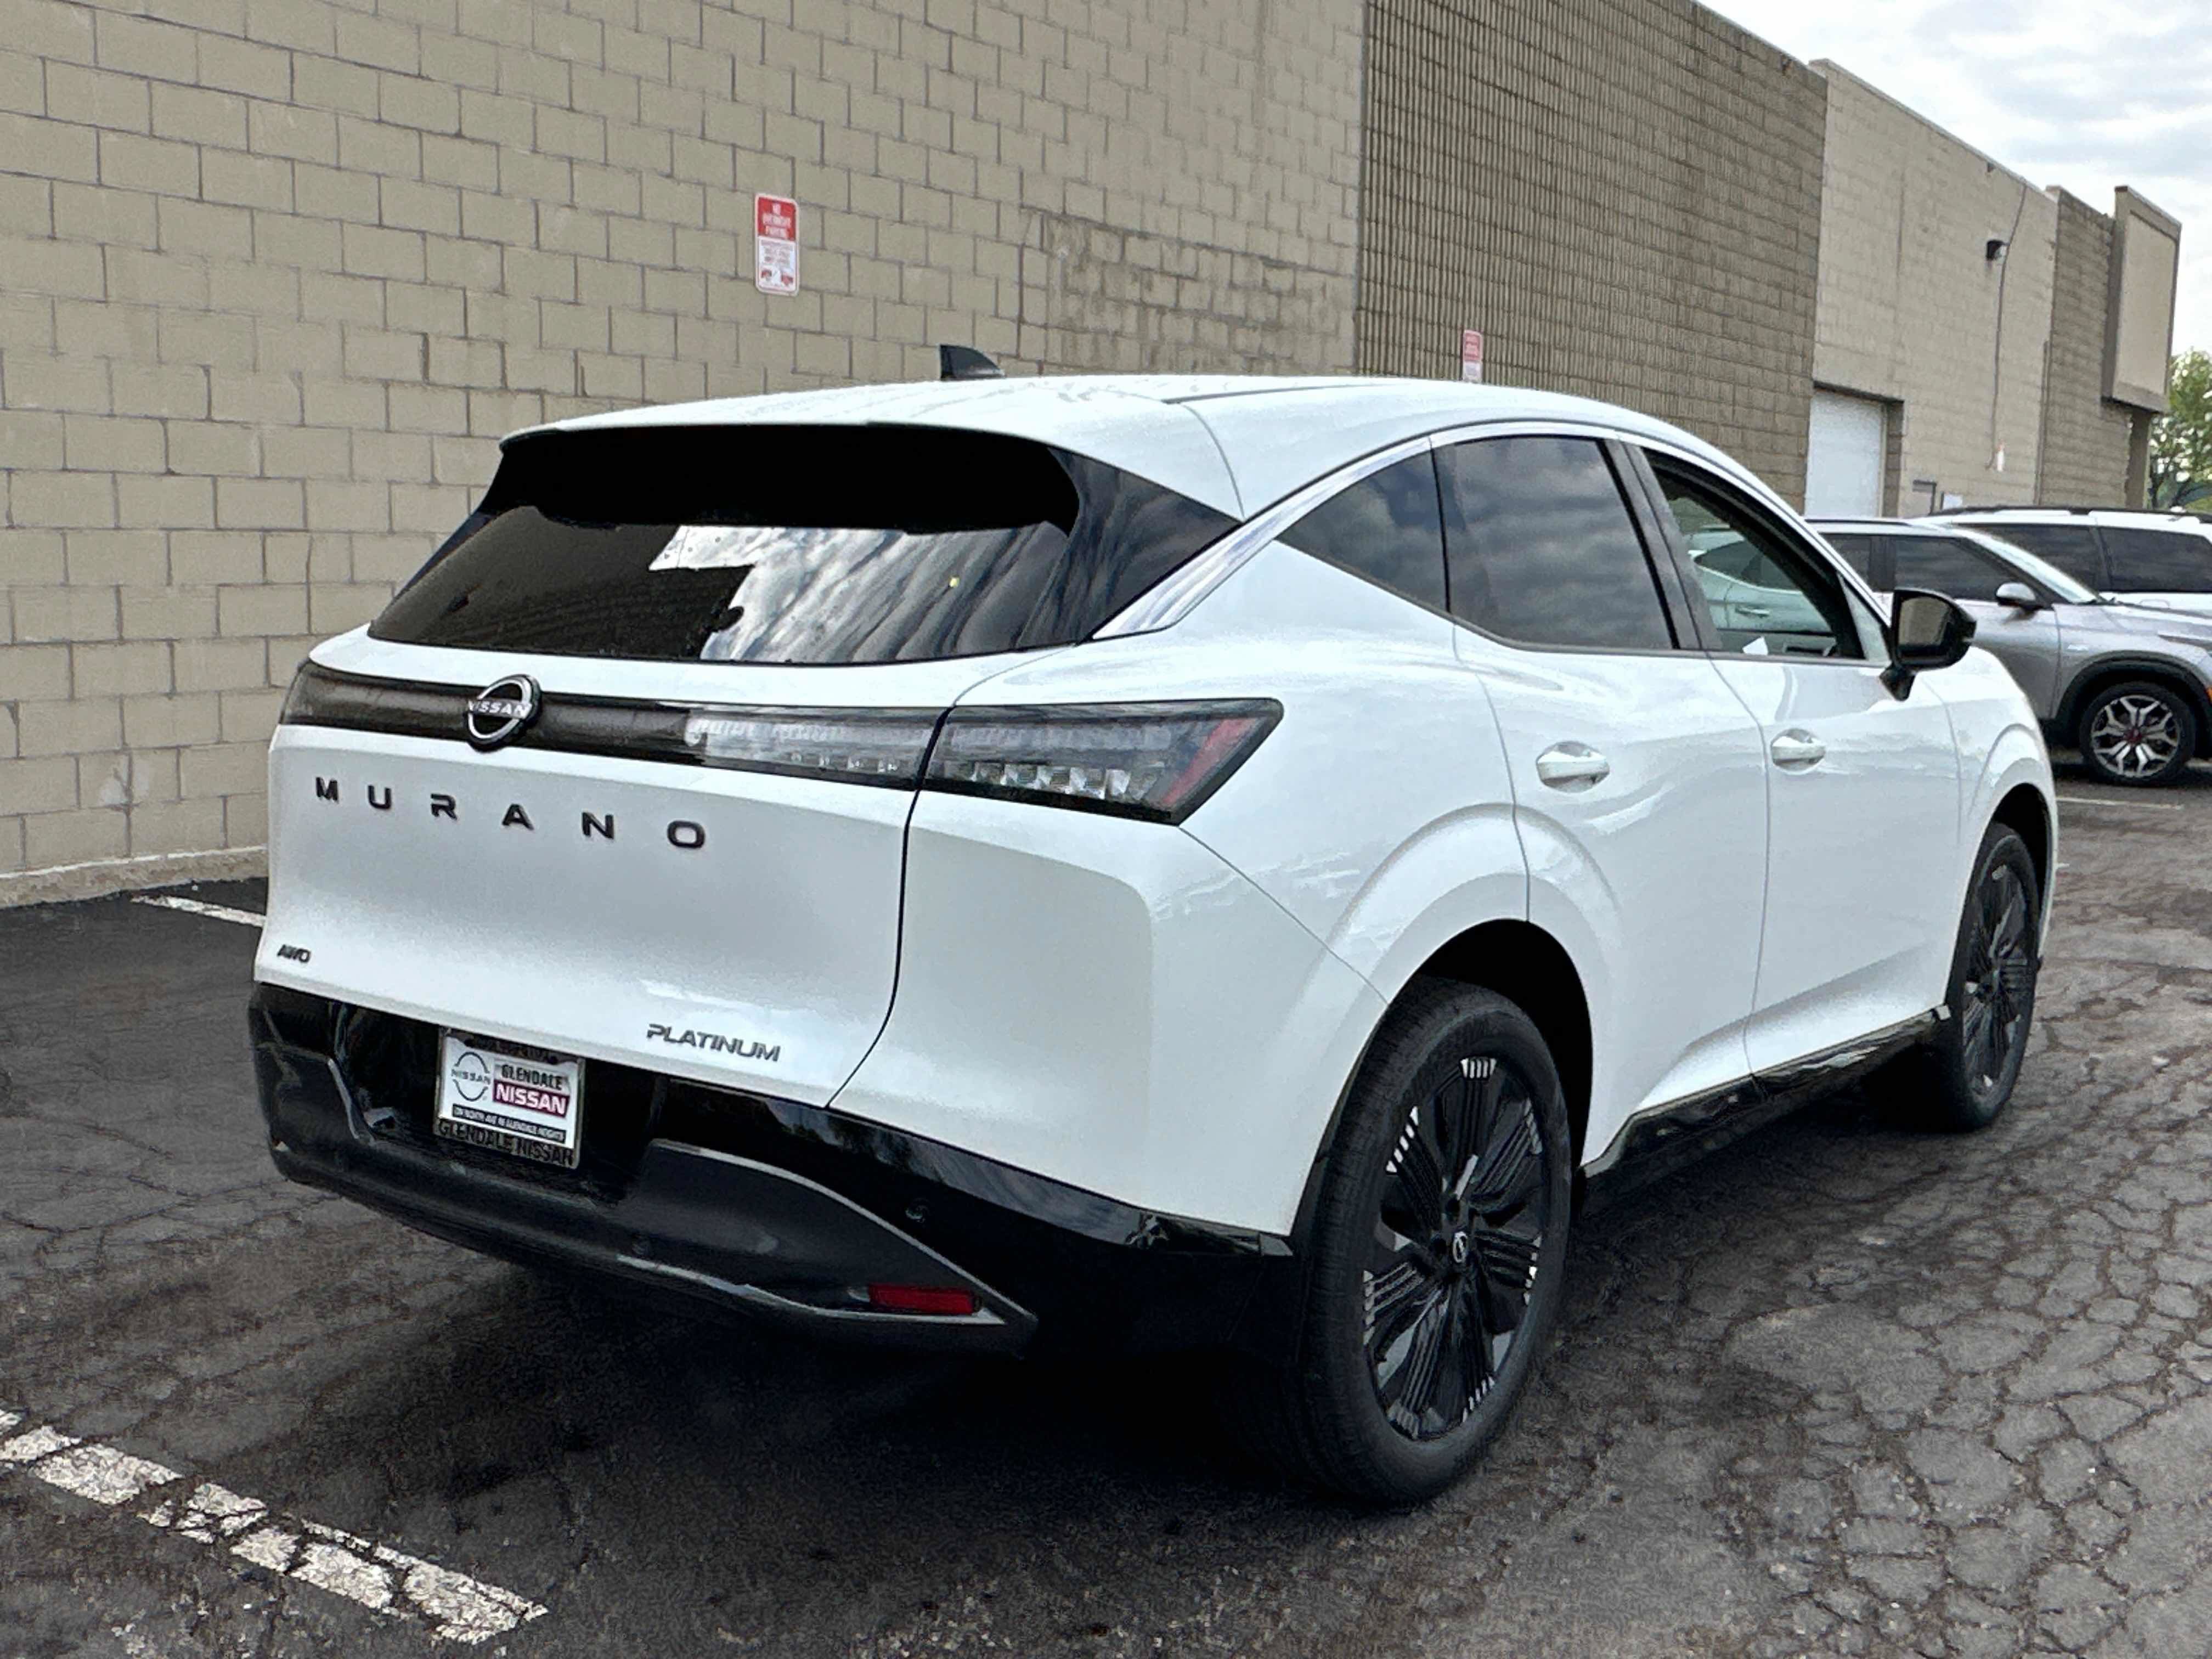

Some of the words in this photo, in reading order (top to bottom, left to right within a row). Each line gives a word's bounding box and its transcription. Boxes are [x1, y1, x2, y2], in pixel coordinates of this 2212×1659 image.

[467, 699, 532, 719] NISSAN
[315, 777, 706, 849] MURANO
[646, 1023, 781, 1062] PLATINUM
[451, 1069, 491, 1085] NISSAN
[501, 1063, 563, 1090] GLENDALE
[495, 1084, 567, 1115] NISSAN
